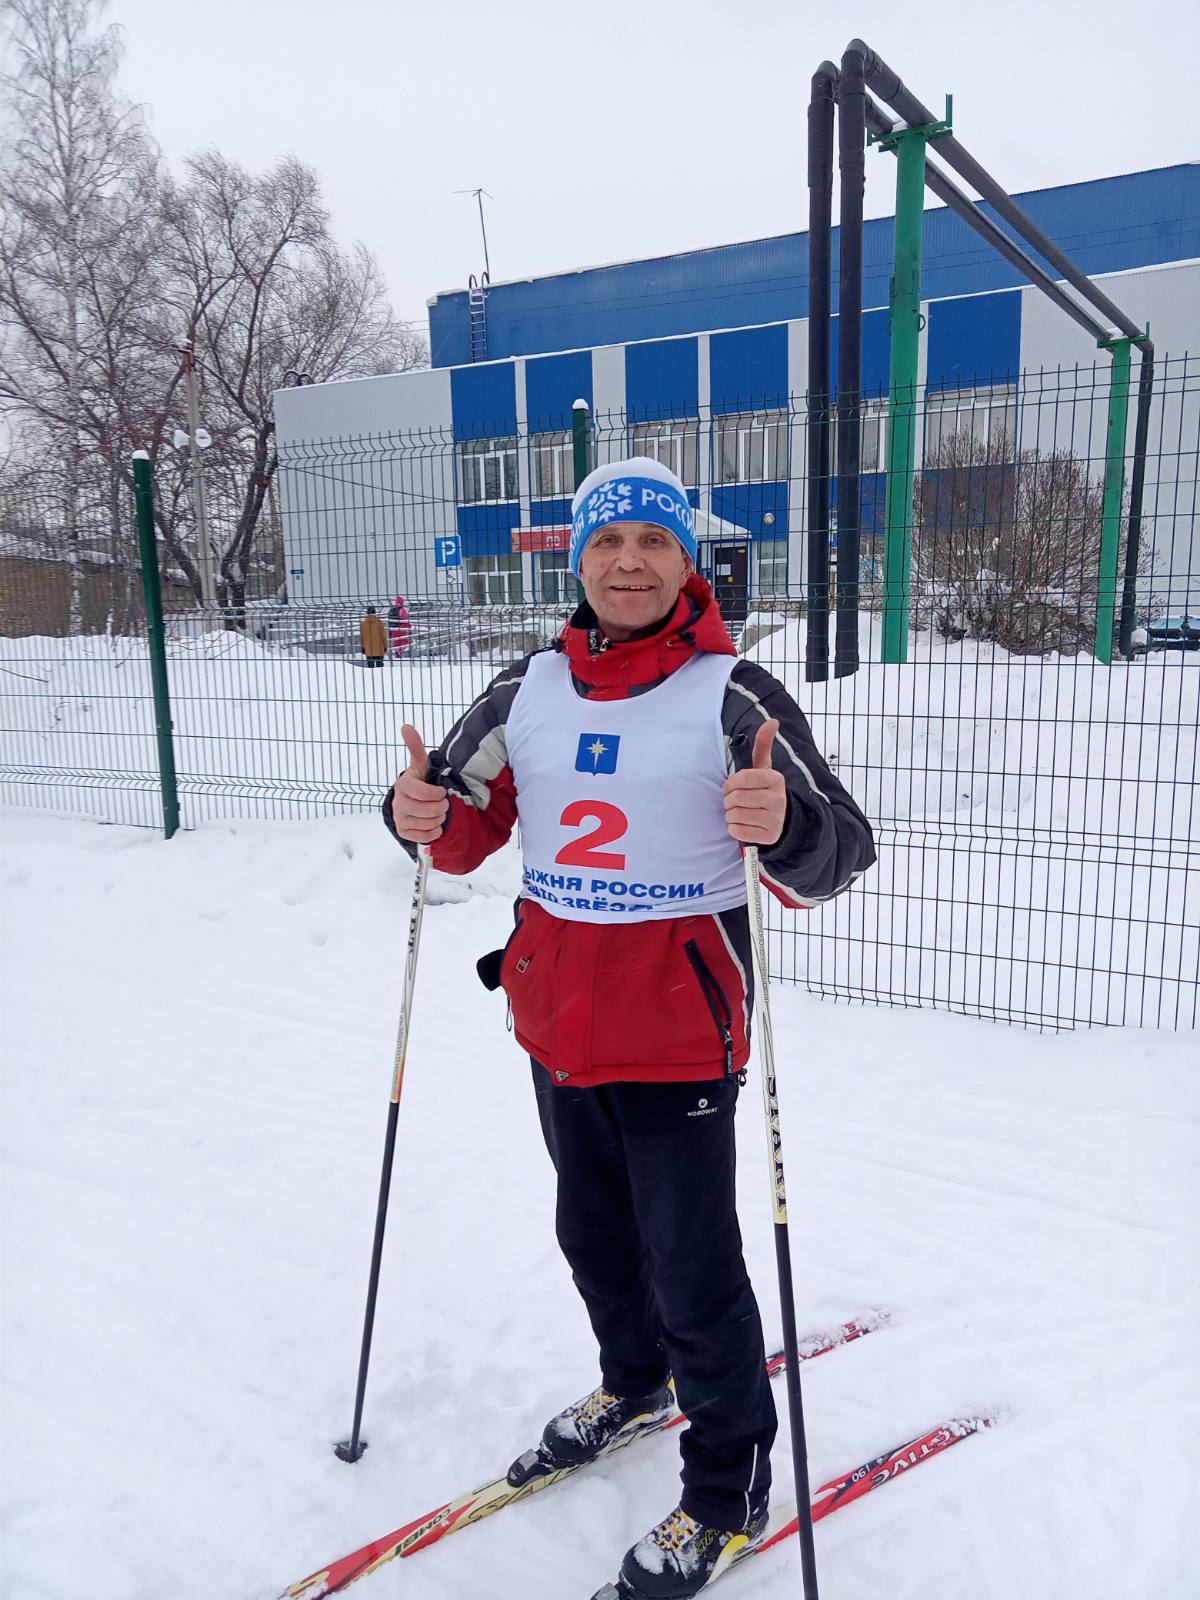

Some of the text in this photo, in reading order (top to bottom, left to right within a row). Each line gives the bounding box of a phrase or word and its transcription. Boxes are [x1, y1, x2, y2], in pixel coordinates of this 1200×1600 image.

[555, 799, 628, 871] 2
[524, 866, 705, 899] ЫЖНЯ РОССИИ
[872, 1425, 957, 1489] CTIVE
